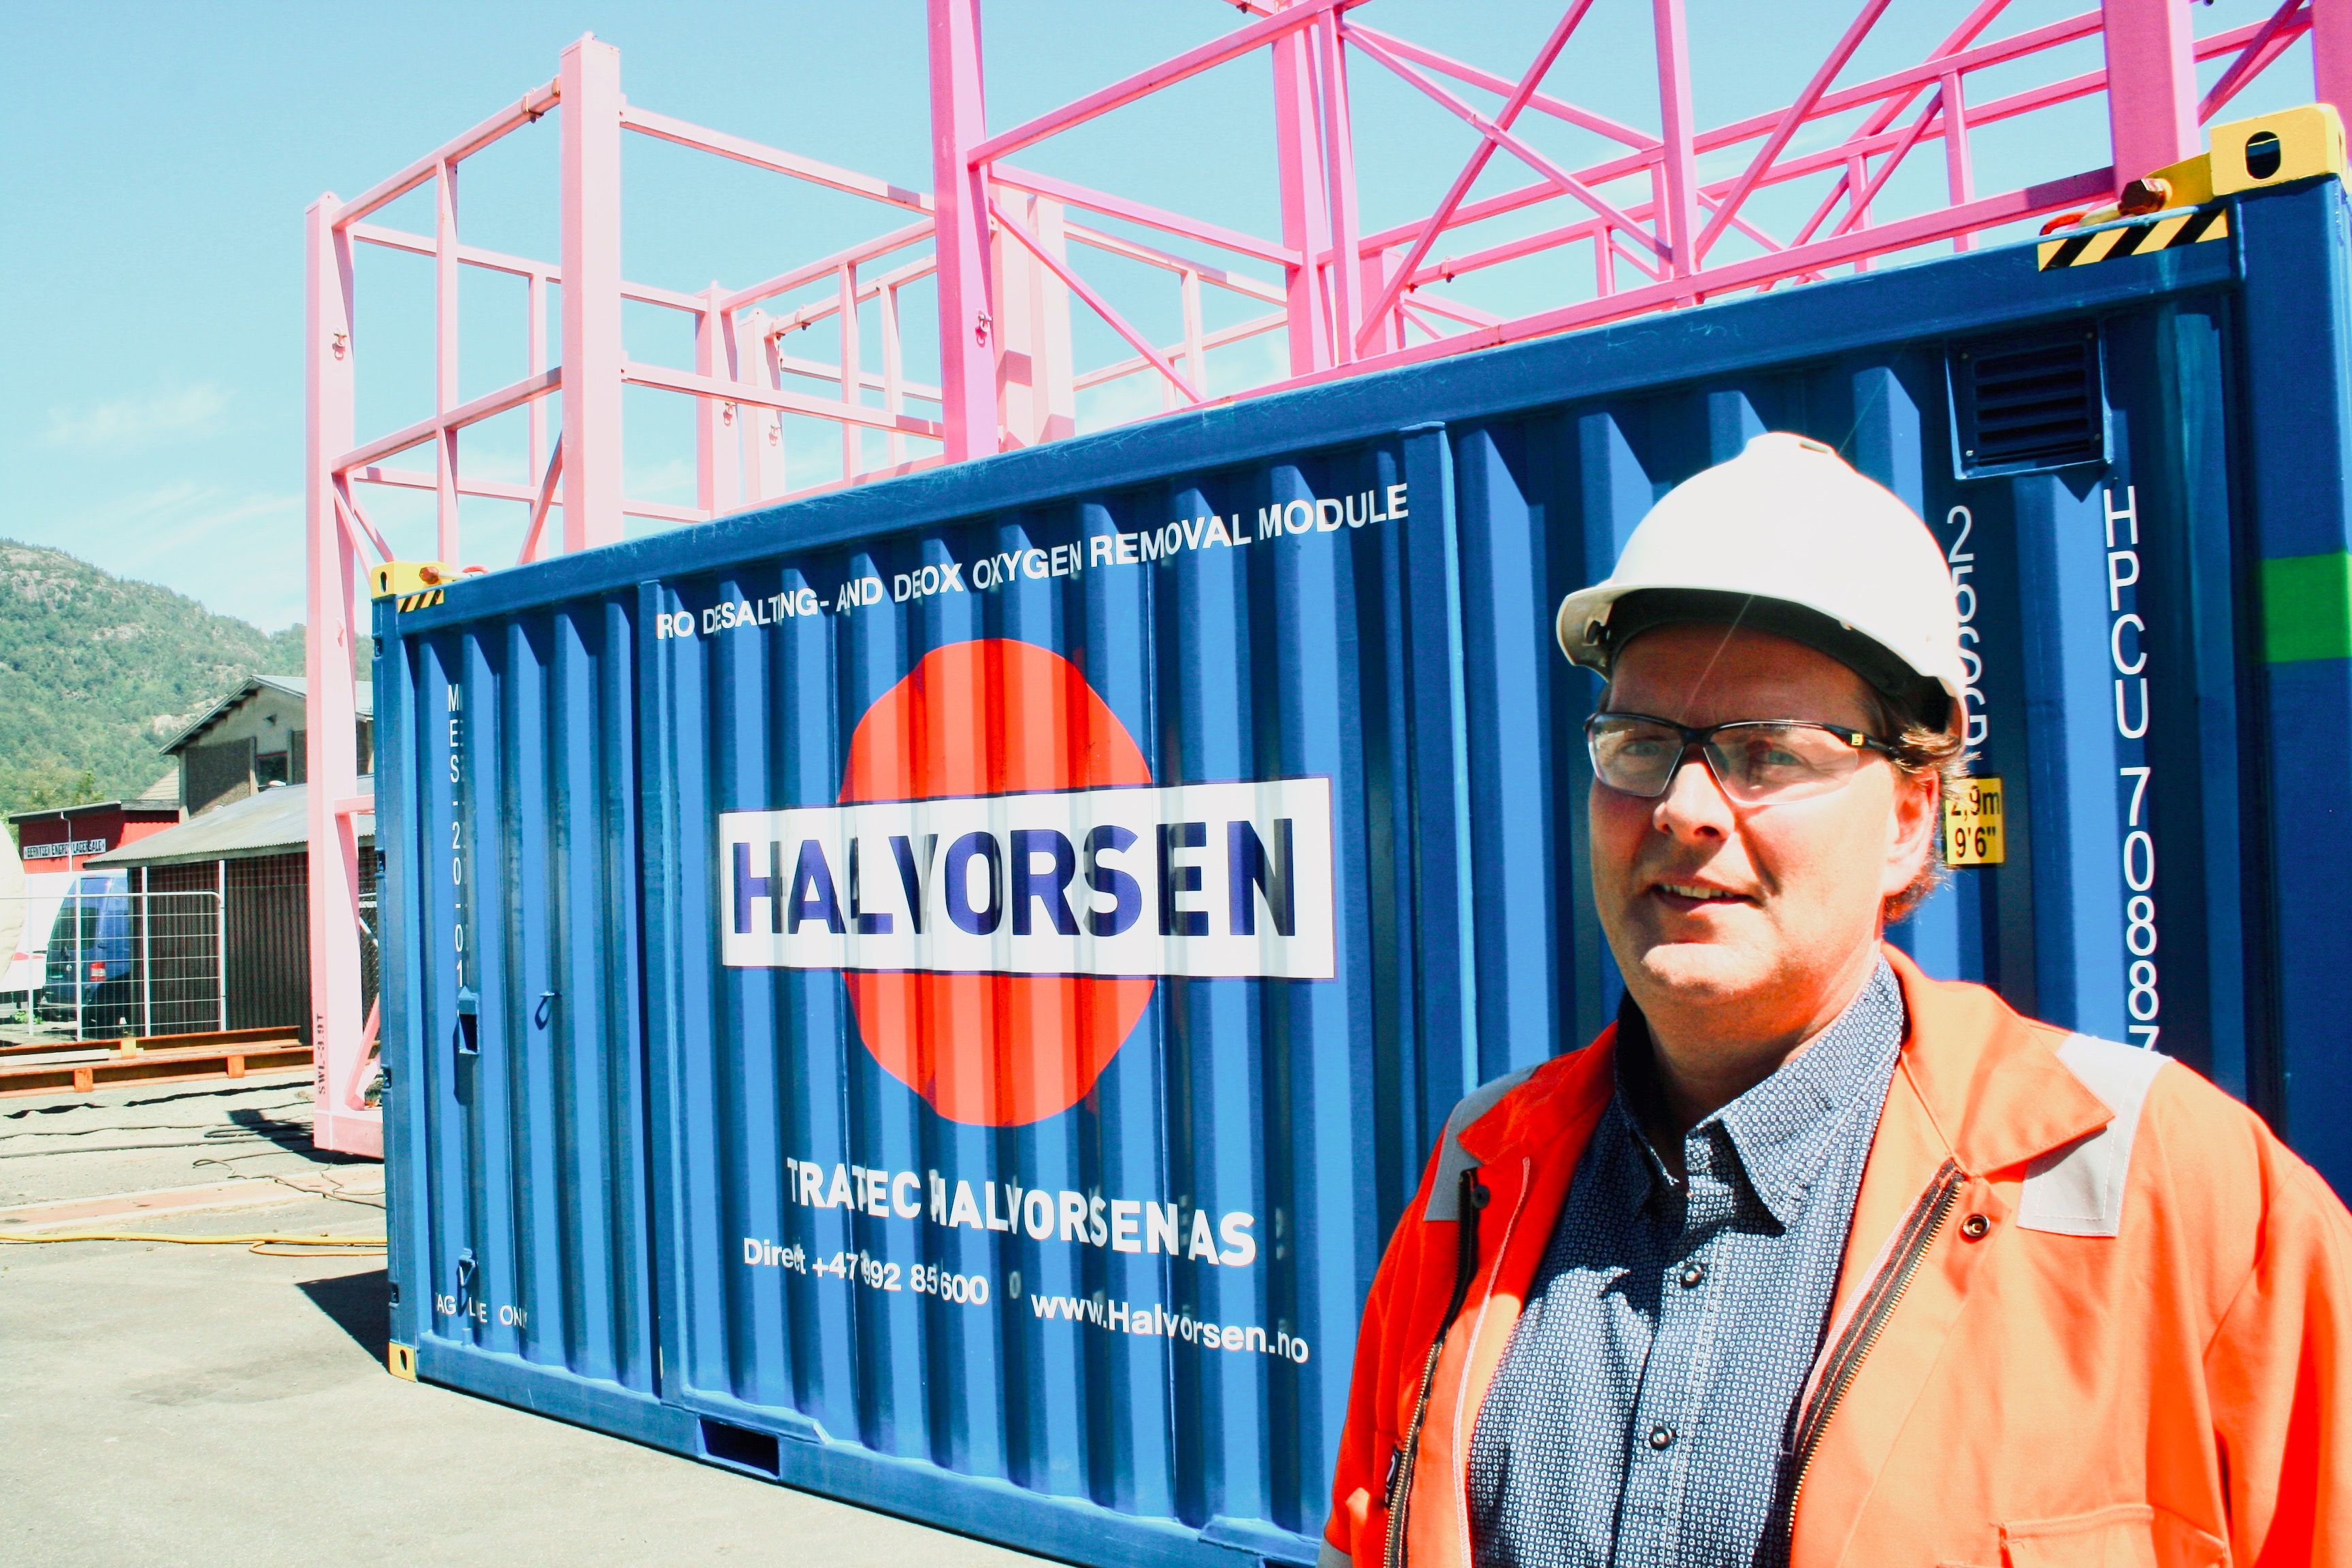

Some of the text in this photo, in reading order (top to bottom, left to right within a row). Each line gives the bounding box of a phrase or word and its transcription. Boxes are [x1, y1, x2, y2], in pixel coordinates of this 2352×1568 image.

[656, 483, 1409, 640] RO DESALTING- AND DEOX OXYGEN REMOVAL MODULE
[2104, 485, 2149, 739] HPCU
[732, 818, 1296, 937] HALVORSEN
[743, 1237, 806, 1275] Direct
[812, 1252, 859, 1280] +47
[787, 1157, 1257, 1267] TRATEC HALVORSEN AS
[435, 1292, 457, 1316] AG
[1030, 1294, 1309, 1363] www.Halvorsen.no
